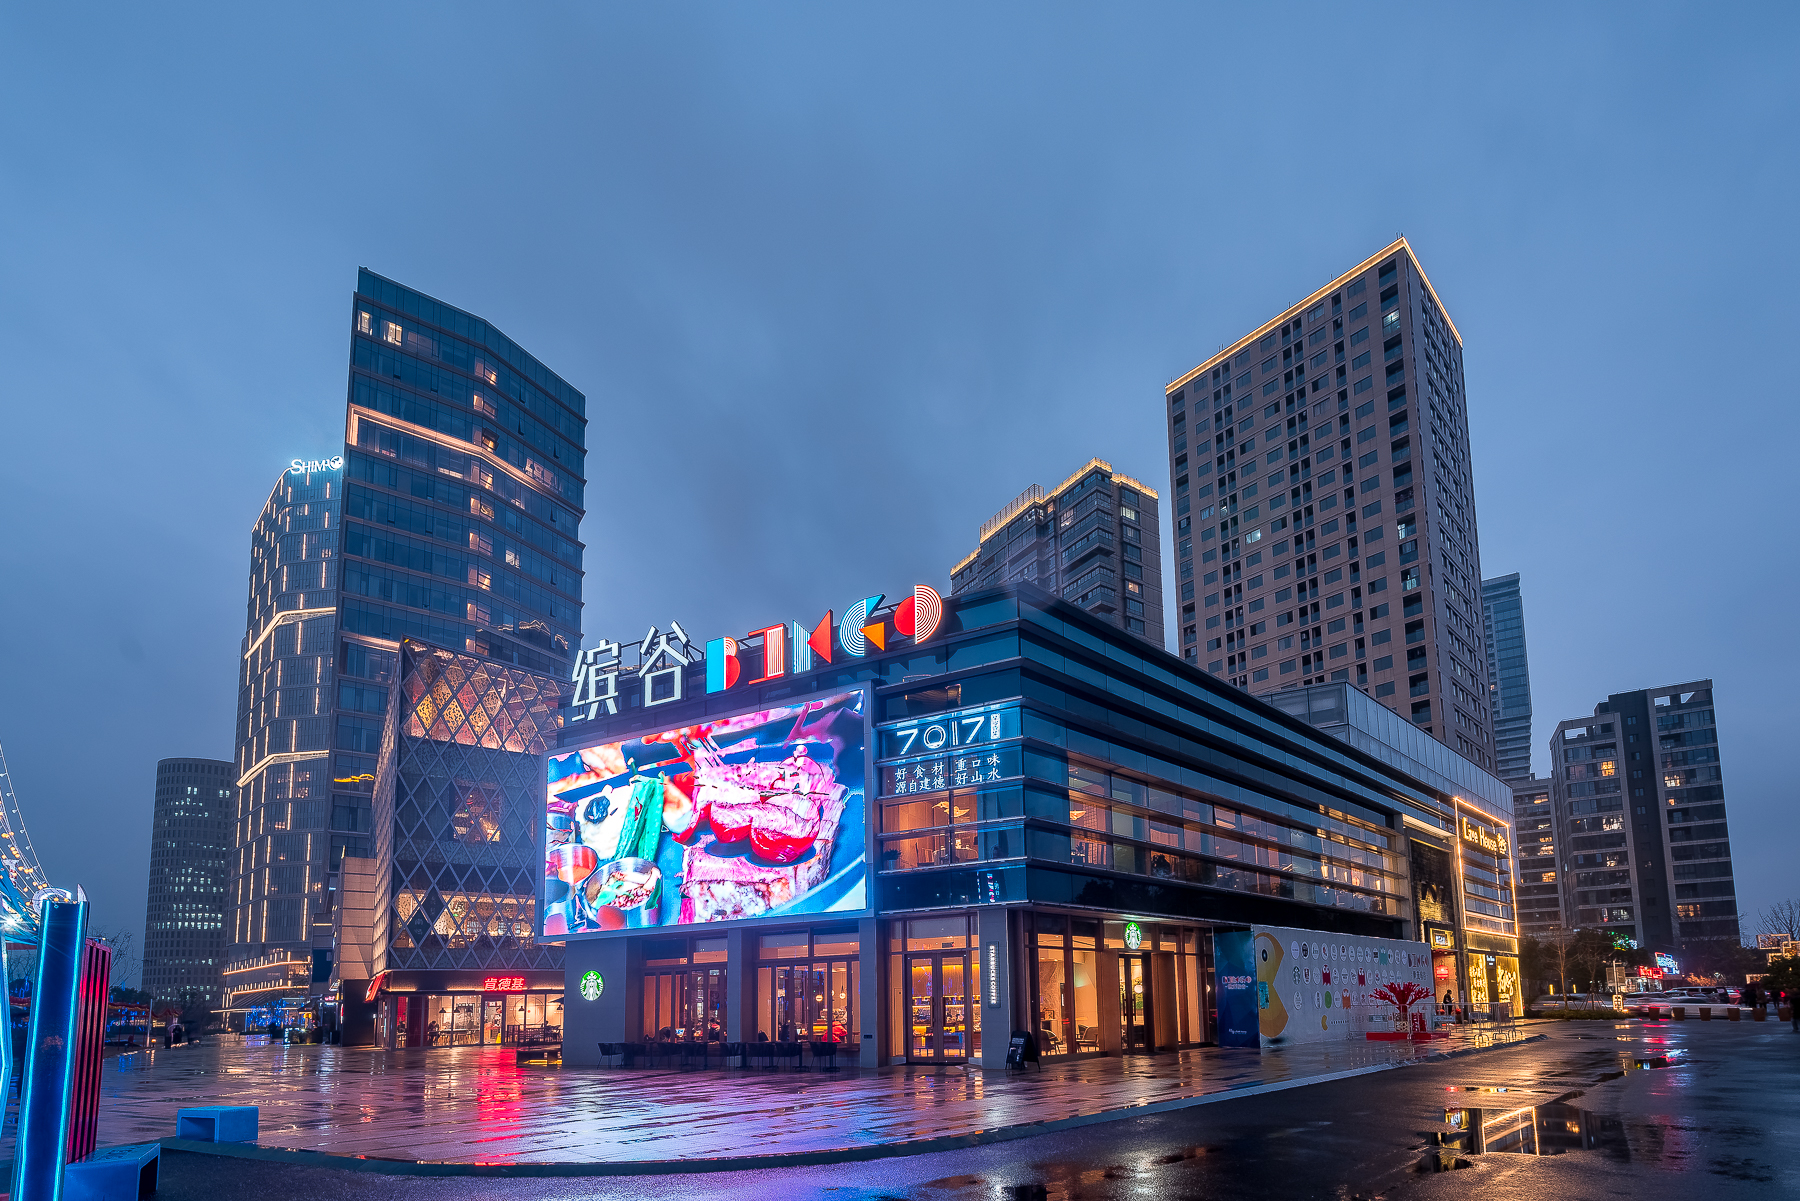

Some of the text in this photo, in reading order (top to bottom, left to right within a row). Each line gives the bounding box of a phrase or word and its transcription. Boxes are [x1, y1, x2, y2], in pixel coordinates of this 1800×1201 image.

[571, 583, 943, 722] 缤谷 BINGO
[894, 752, 1001, 782] 好食材 重口味
[894, 767, 1002, 794] 源自建德 好山水
[1477, 825, 1498, 852] House
[484, 977, 525, 991] 肯德基
